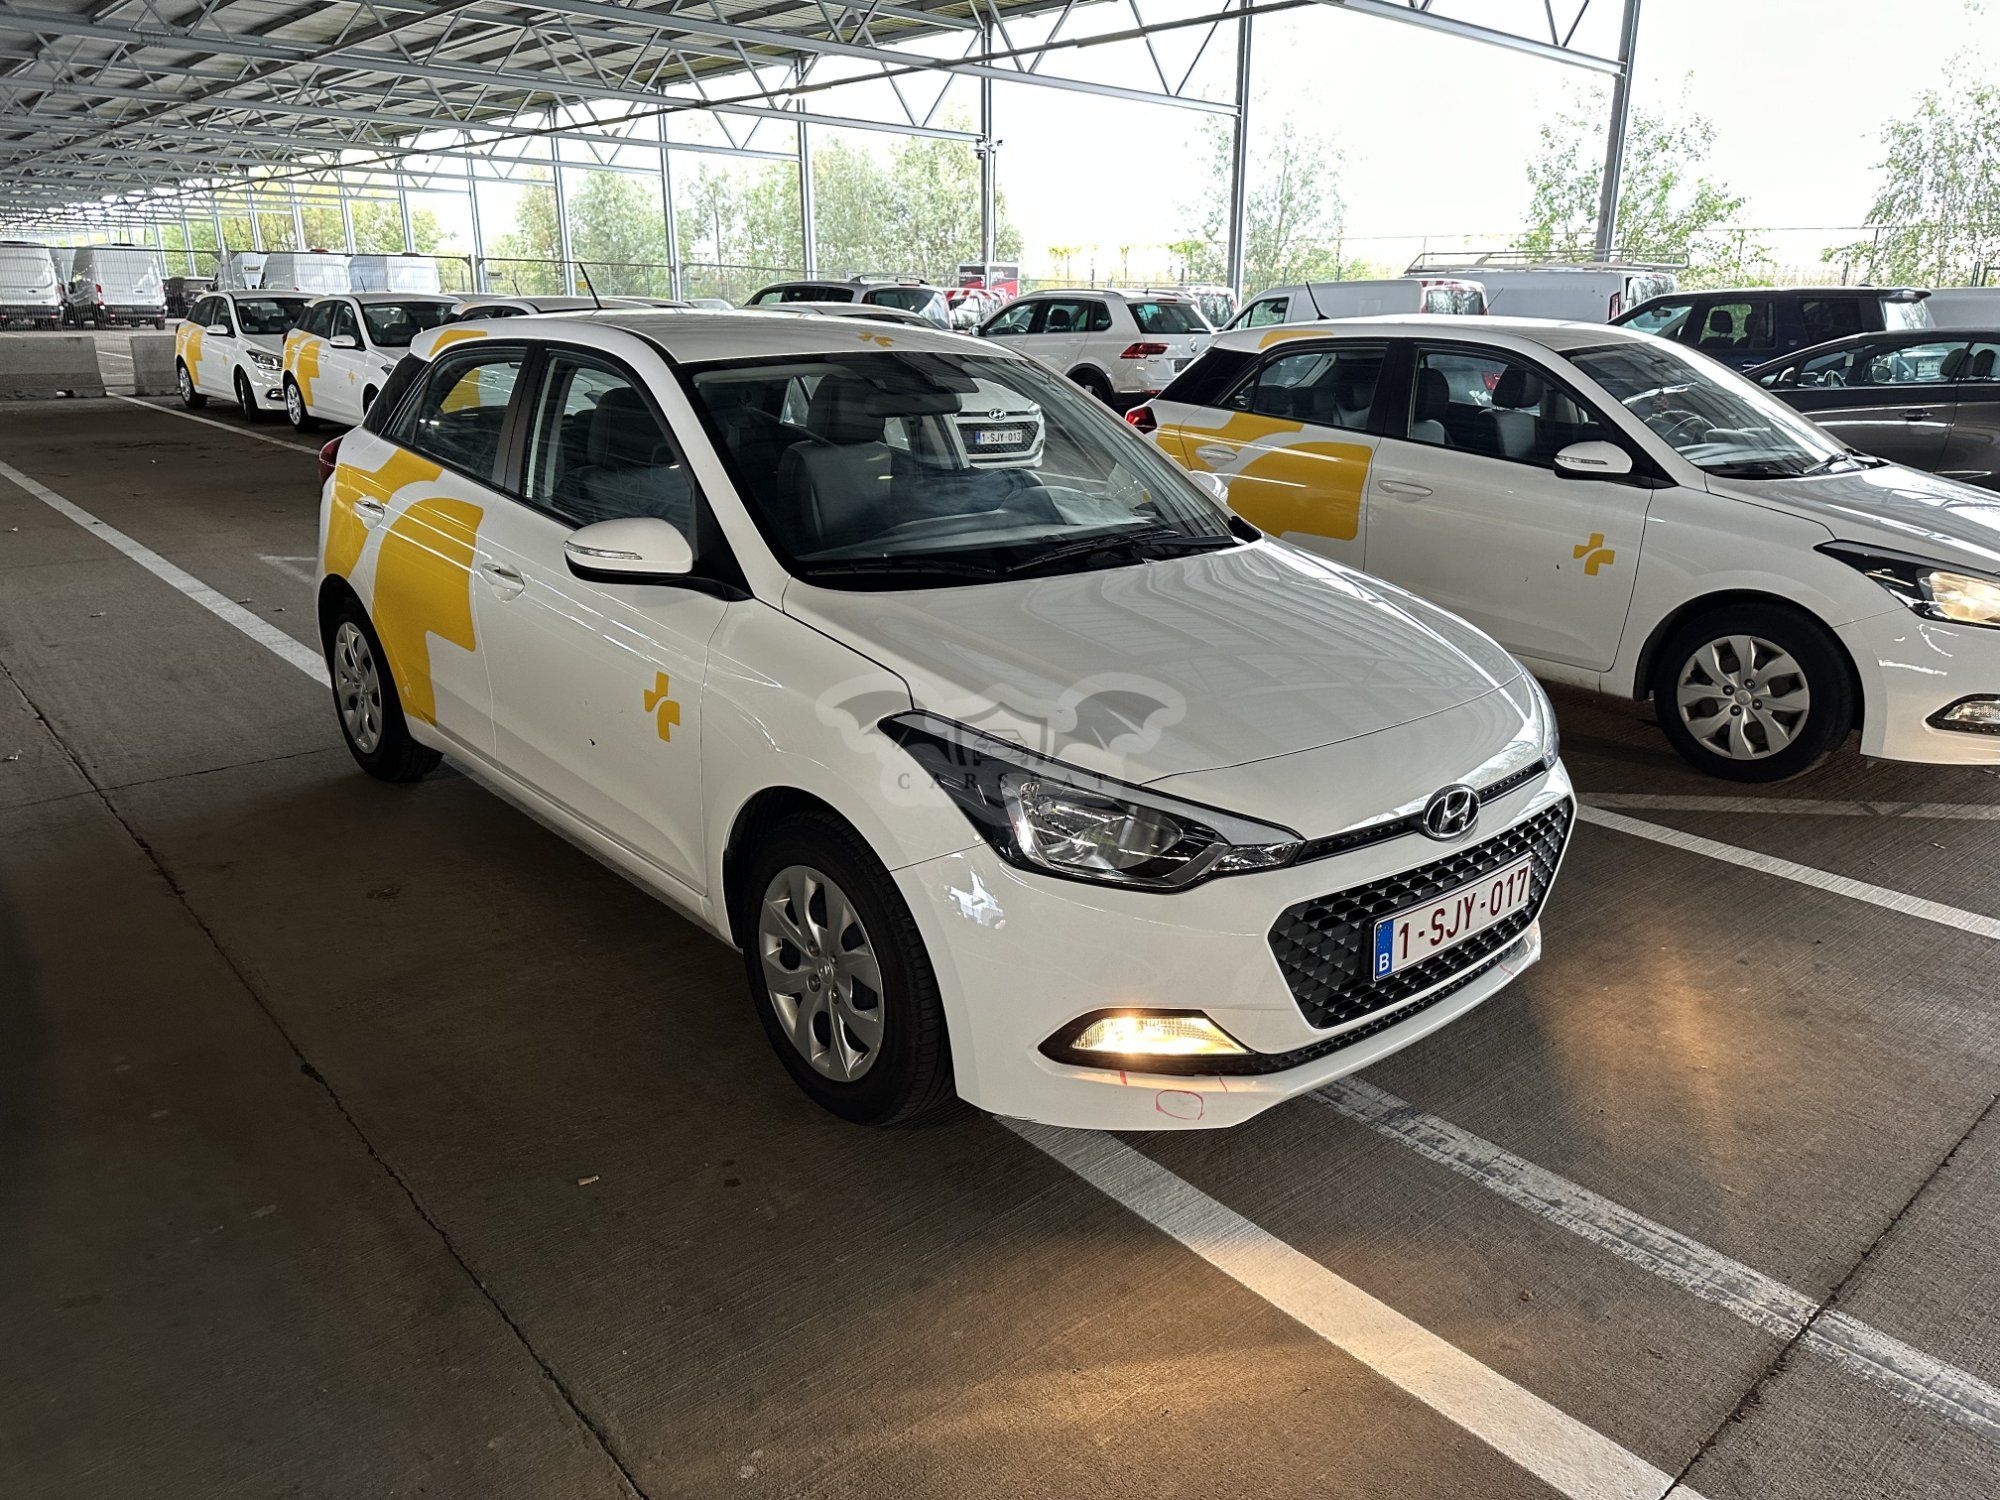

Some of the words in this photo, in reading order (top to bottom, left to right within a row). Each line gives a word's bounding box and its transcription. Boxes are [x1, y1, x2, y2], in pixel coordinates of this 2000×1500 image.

[982, 432, 1021, 443] 1-SJY-013
[1399, 865, 1529, 960] 1-SJY-017
[1378, 953, 1390, 973] B
